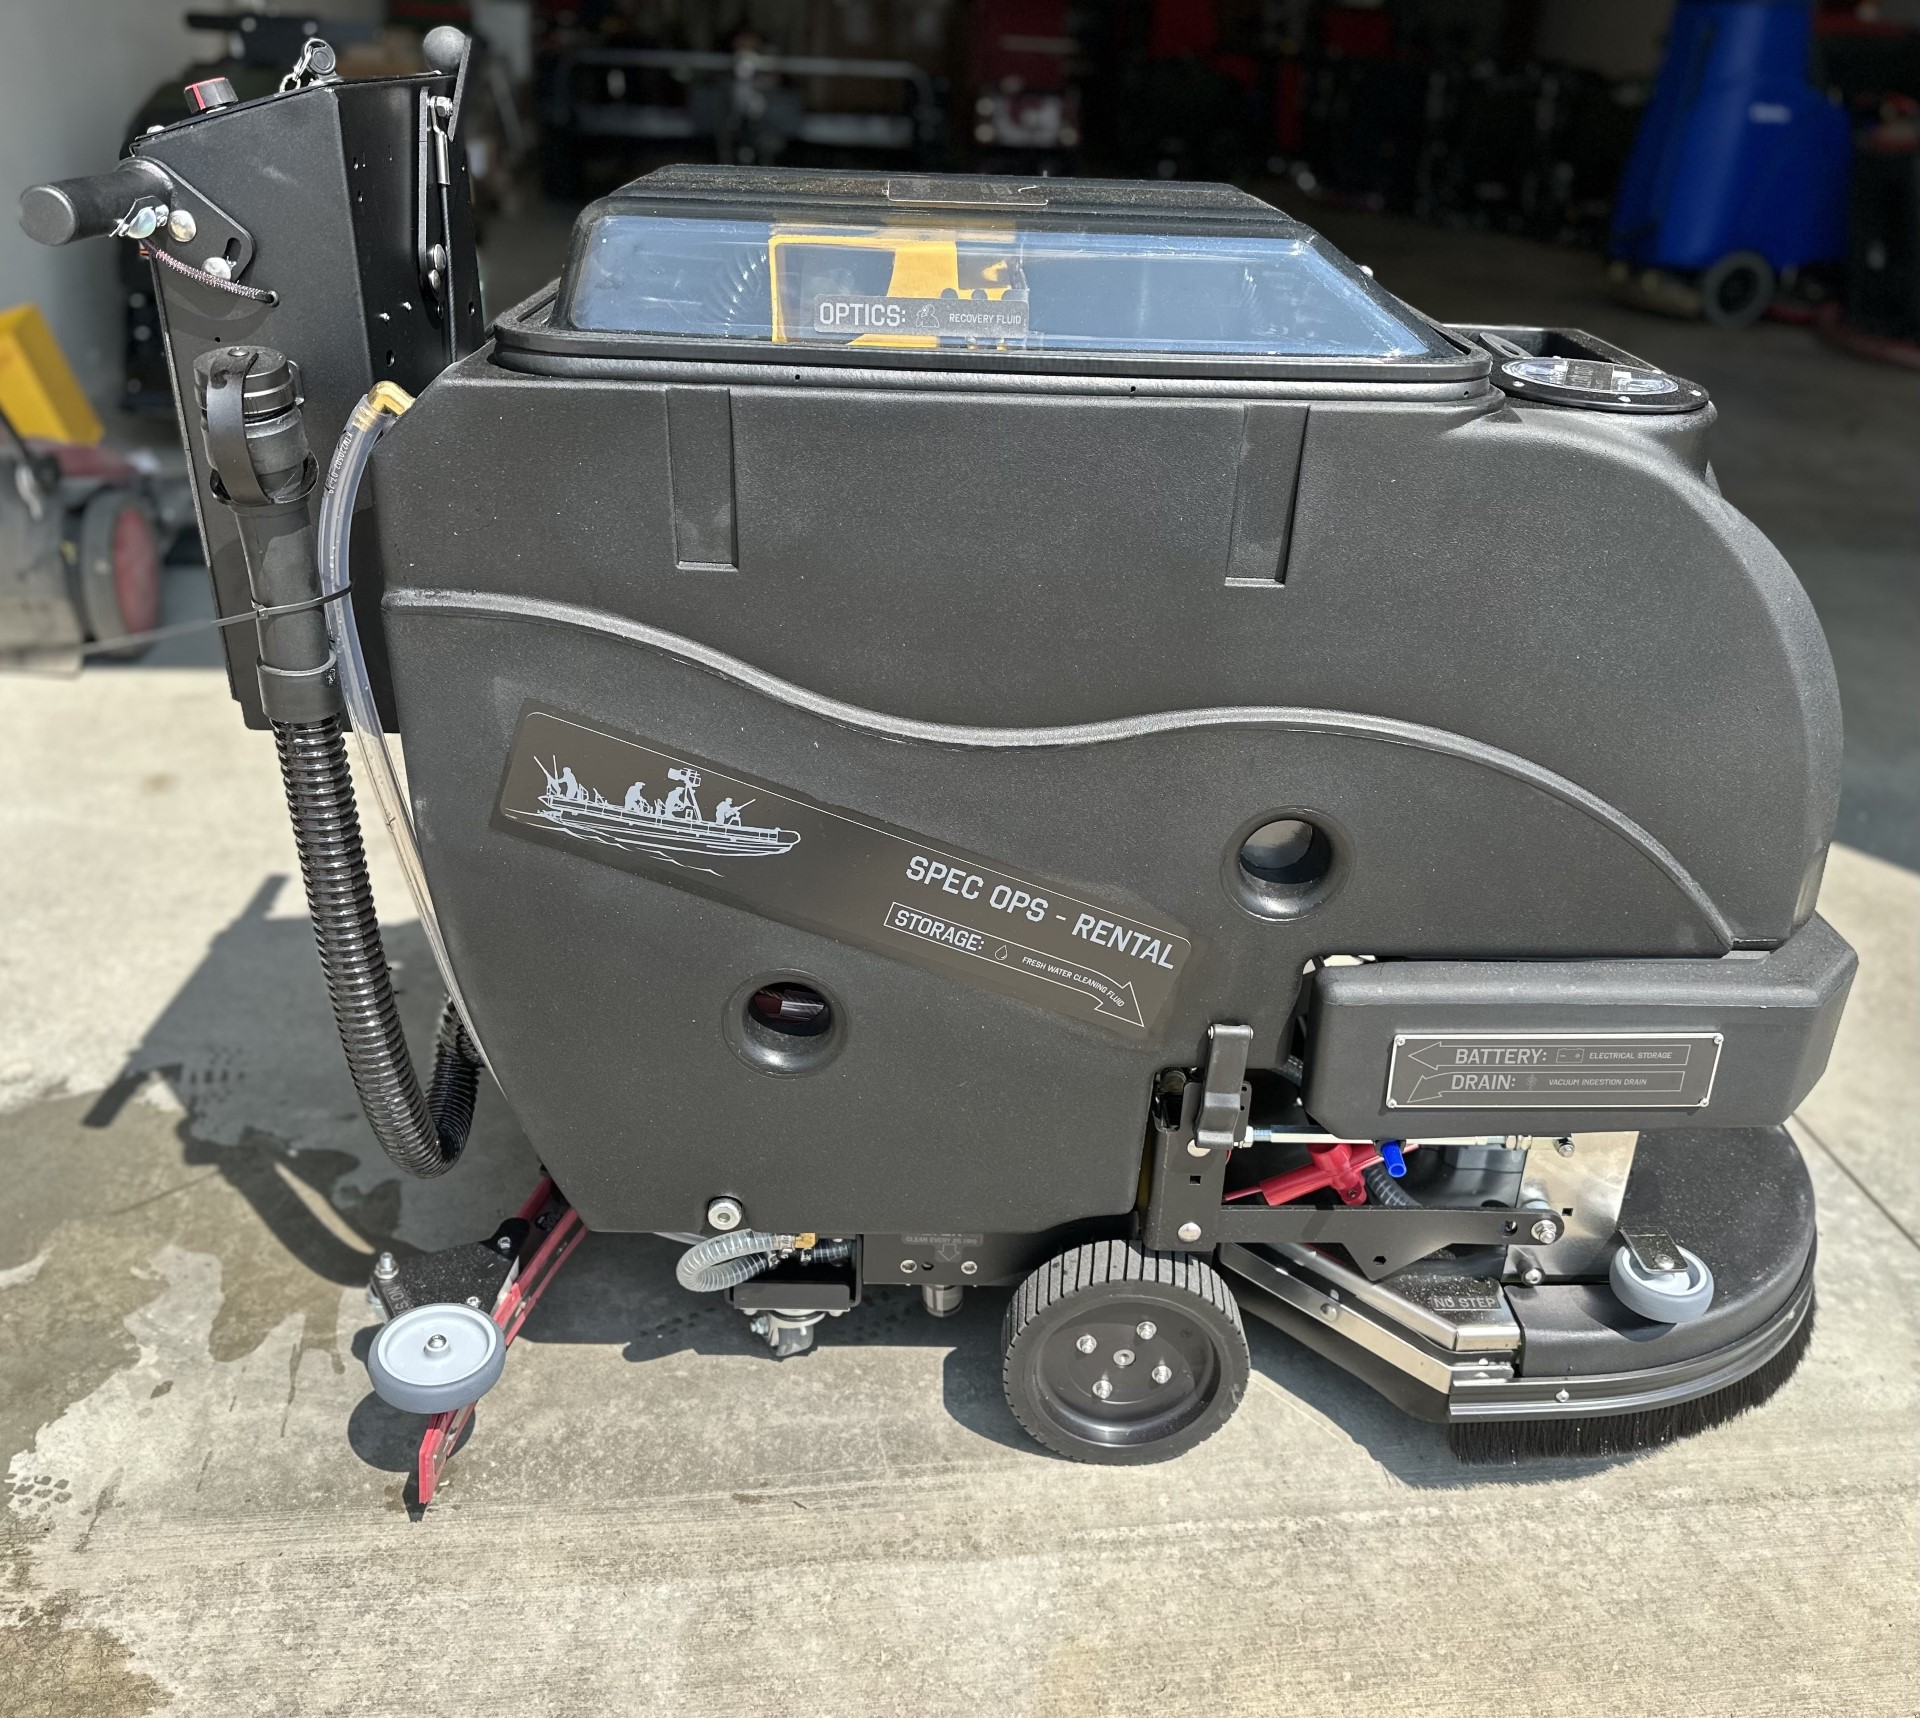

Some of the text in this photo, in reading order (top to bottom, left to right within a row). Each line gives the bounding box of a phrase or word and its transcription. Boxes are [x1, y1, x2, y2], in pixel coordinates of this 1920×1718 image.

[819, 302, 1022, 327] OPTICS: RECOVERY FLUID
[905, 855, 984, 900] SPEC
[989, 884, 1048, 922] OPS
[1071, 912, 1175, 970] RENTAL
[894, 909, 1125, 1008] STORAGE: FRESH WATER CLEANING FLUID
[1455, 1048, 1672, 1065] BATTERY: ELECTRICAL STORAGE
[1451, 1074, 1647, 1090] DRAIN: VACUUM INGESTION DRAIN
[388, 1286, 405, 1302] NO
[1434, 1297, 1496, 1308] NO STEP
